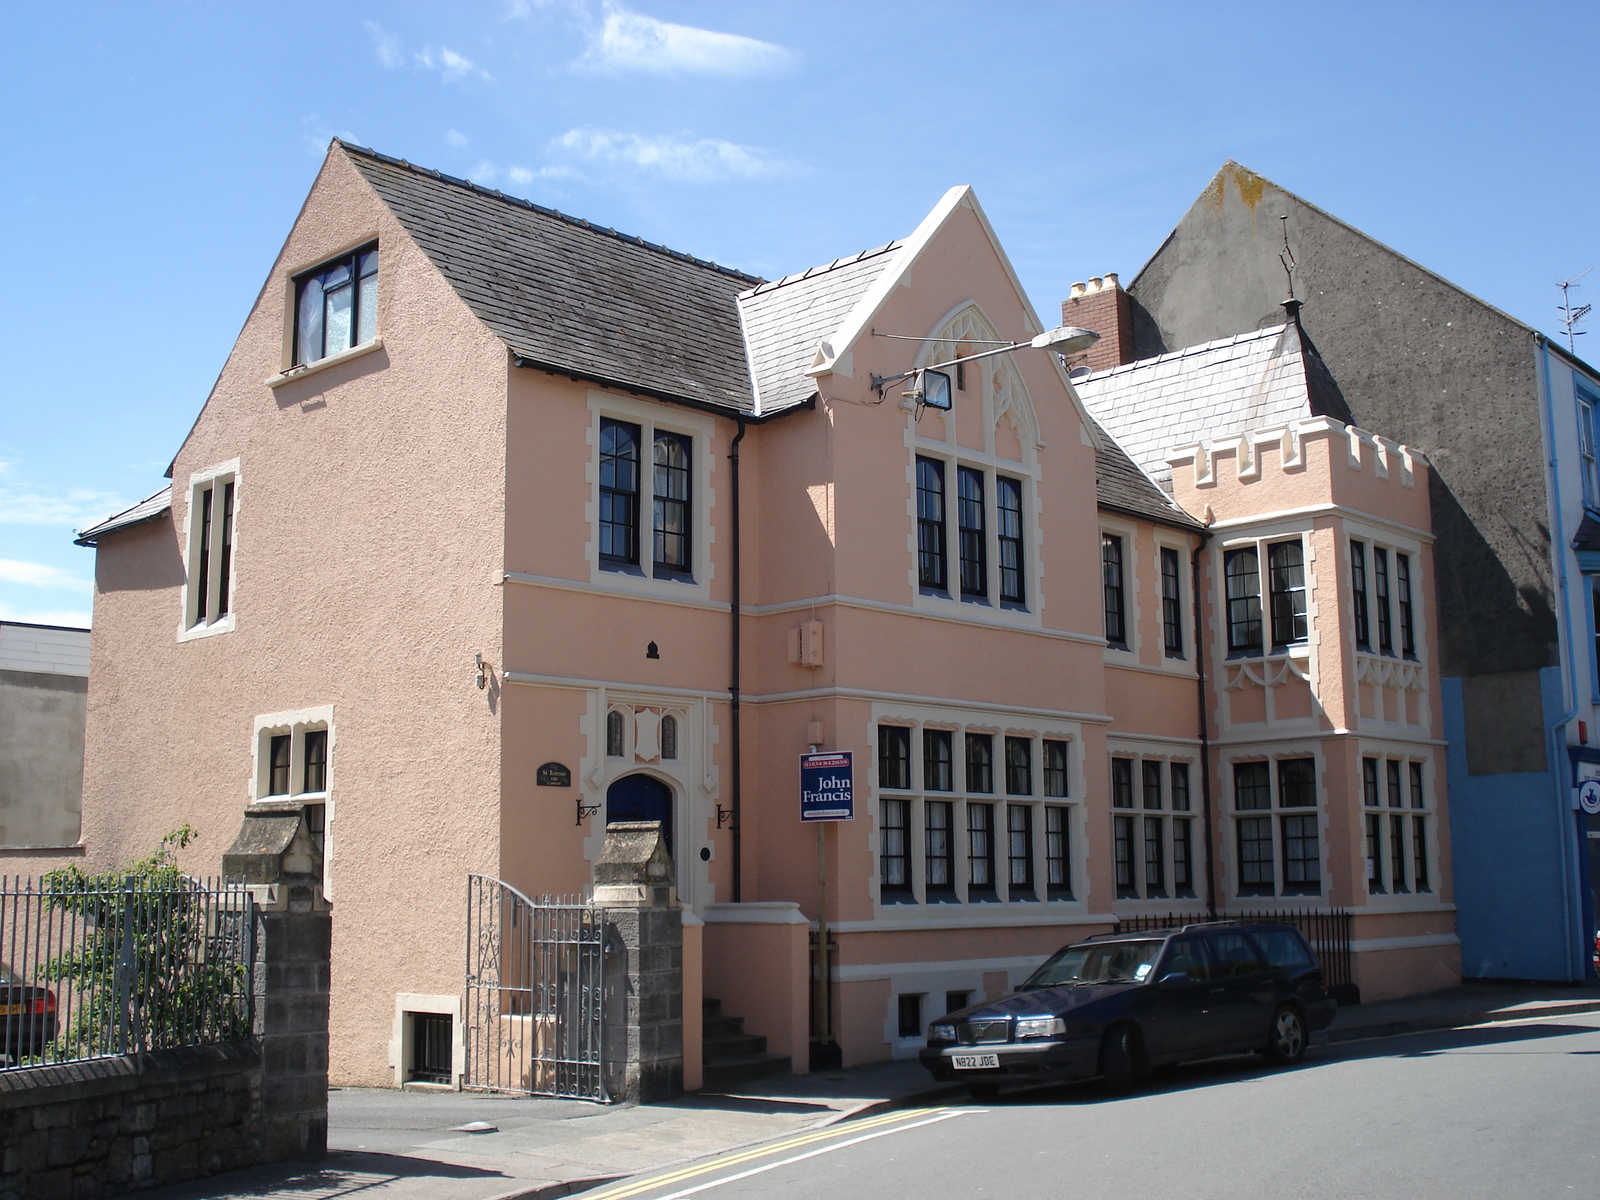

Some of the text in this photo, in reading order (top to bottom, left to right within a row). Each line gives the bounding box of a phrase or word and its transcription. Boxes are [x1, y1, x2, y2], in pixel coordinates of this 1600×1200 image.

[818, 776, 851, 791] John
[803, 789, 851, 802] Francis
[956, 1056, 995, 1067] N822 JDE
